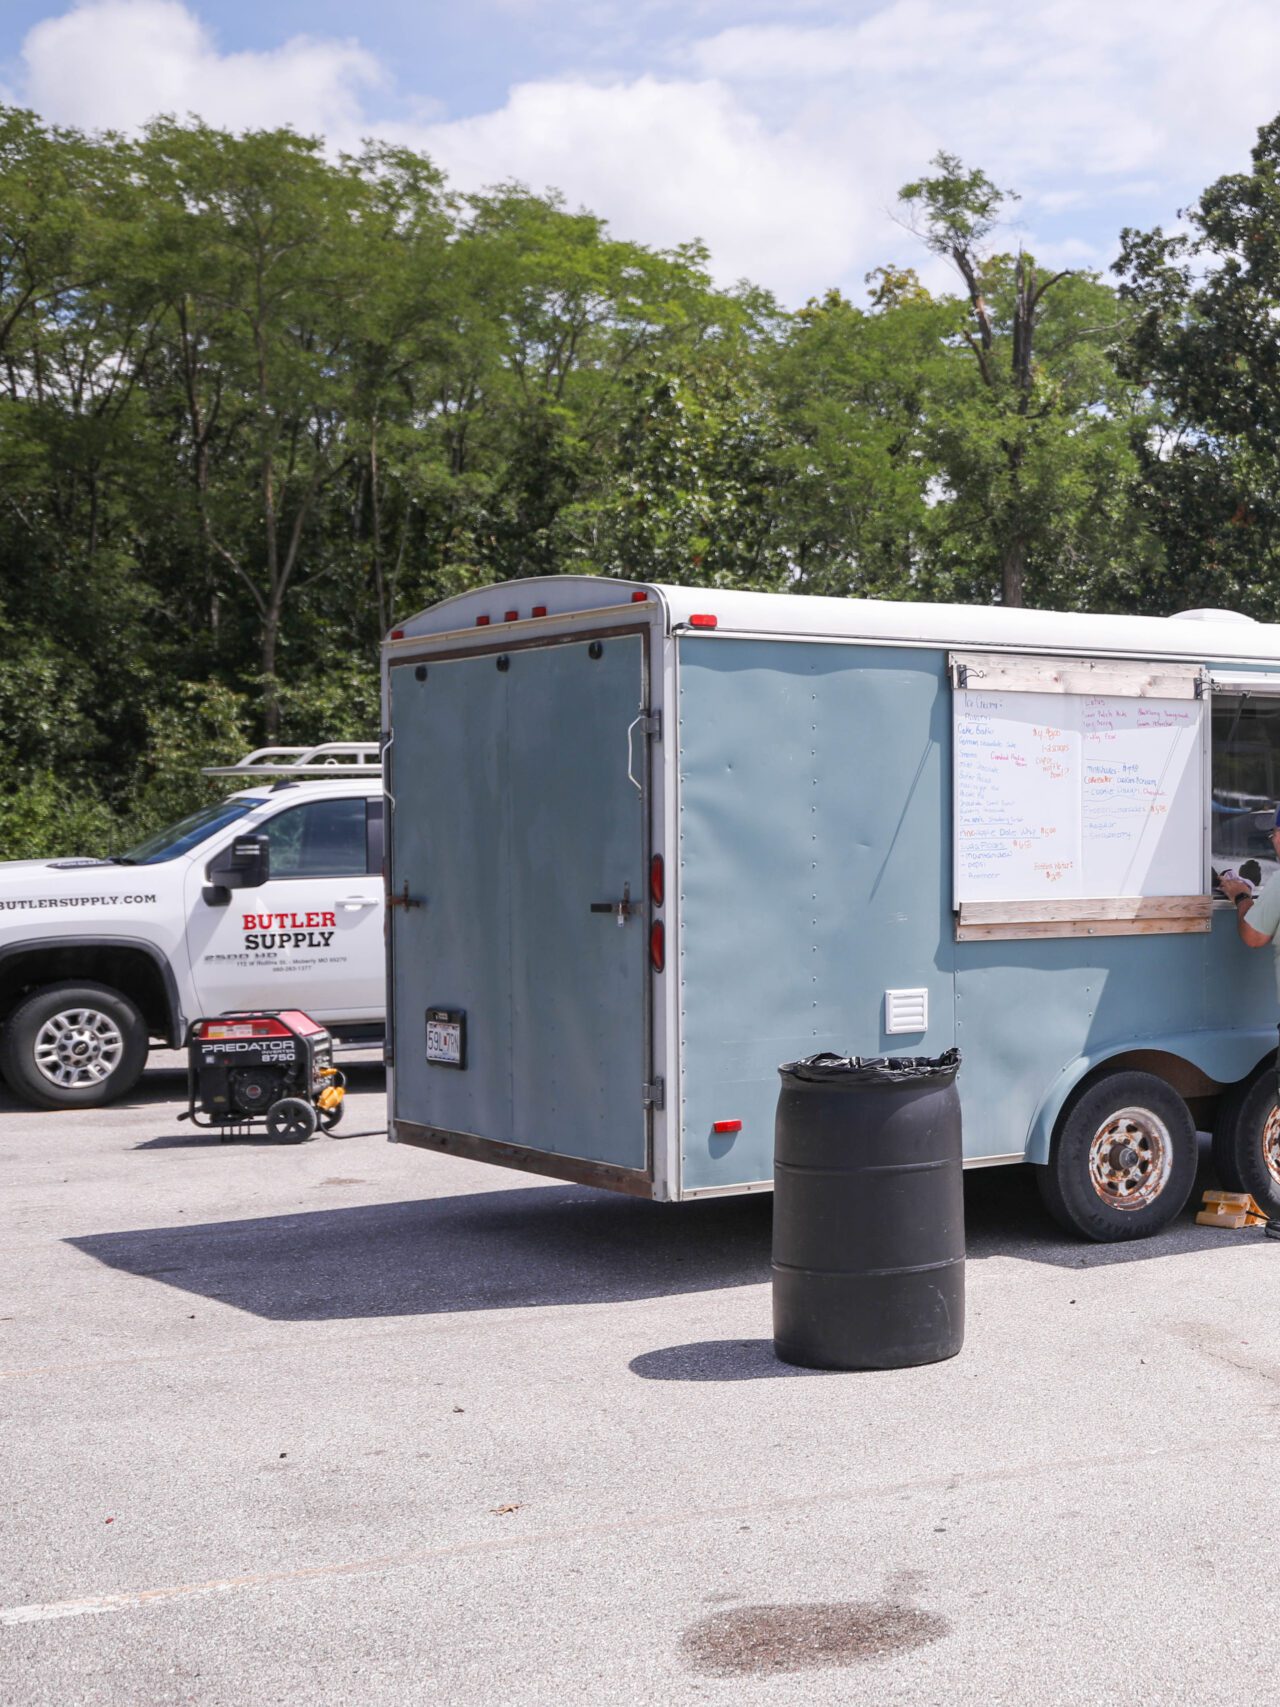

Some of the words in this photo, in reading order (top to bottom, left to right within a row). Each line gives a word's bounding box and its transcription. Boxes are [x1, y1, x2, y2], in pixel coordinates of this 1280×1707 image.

[242, 911, 337, 930] BUTLER
[245, 931, 335, 950] SUPPLY
[201, 1040, 295, 1054] PREDATOR
[261, 1053, 295, 1062] 8750
